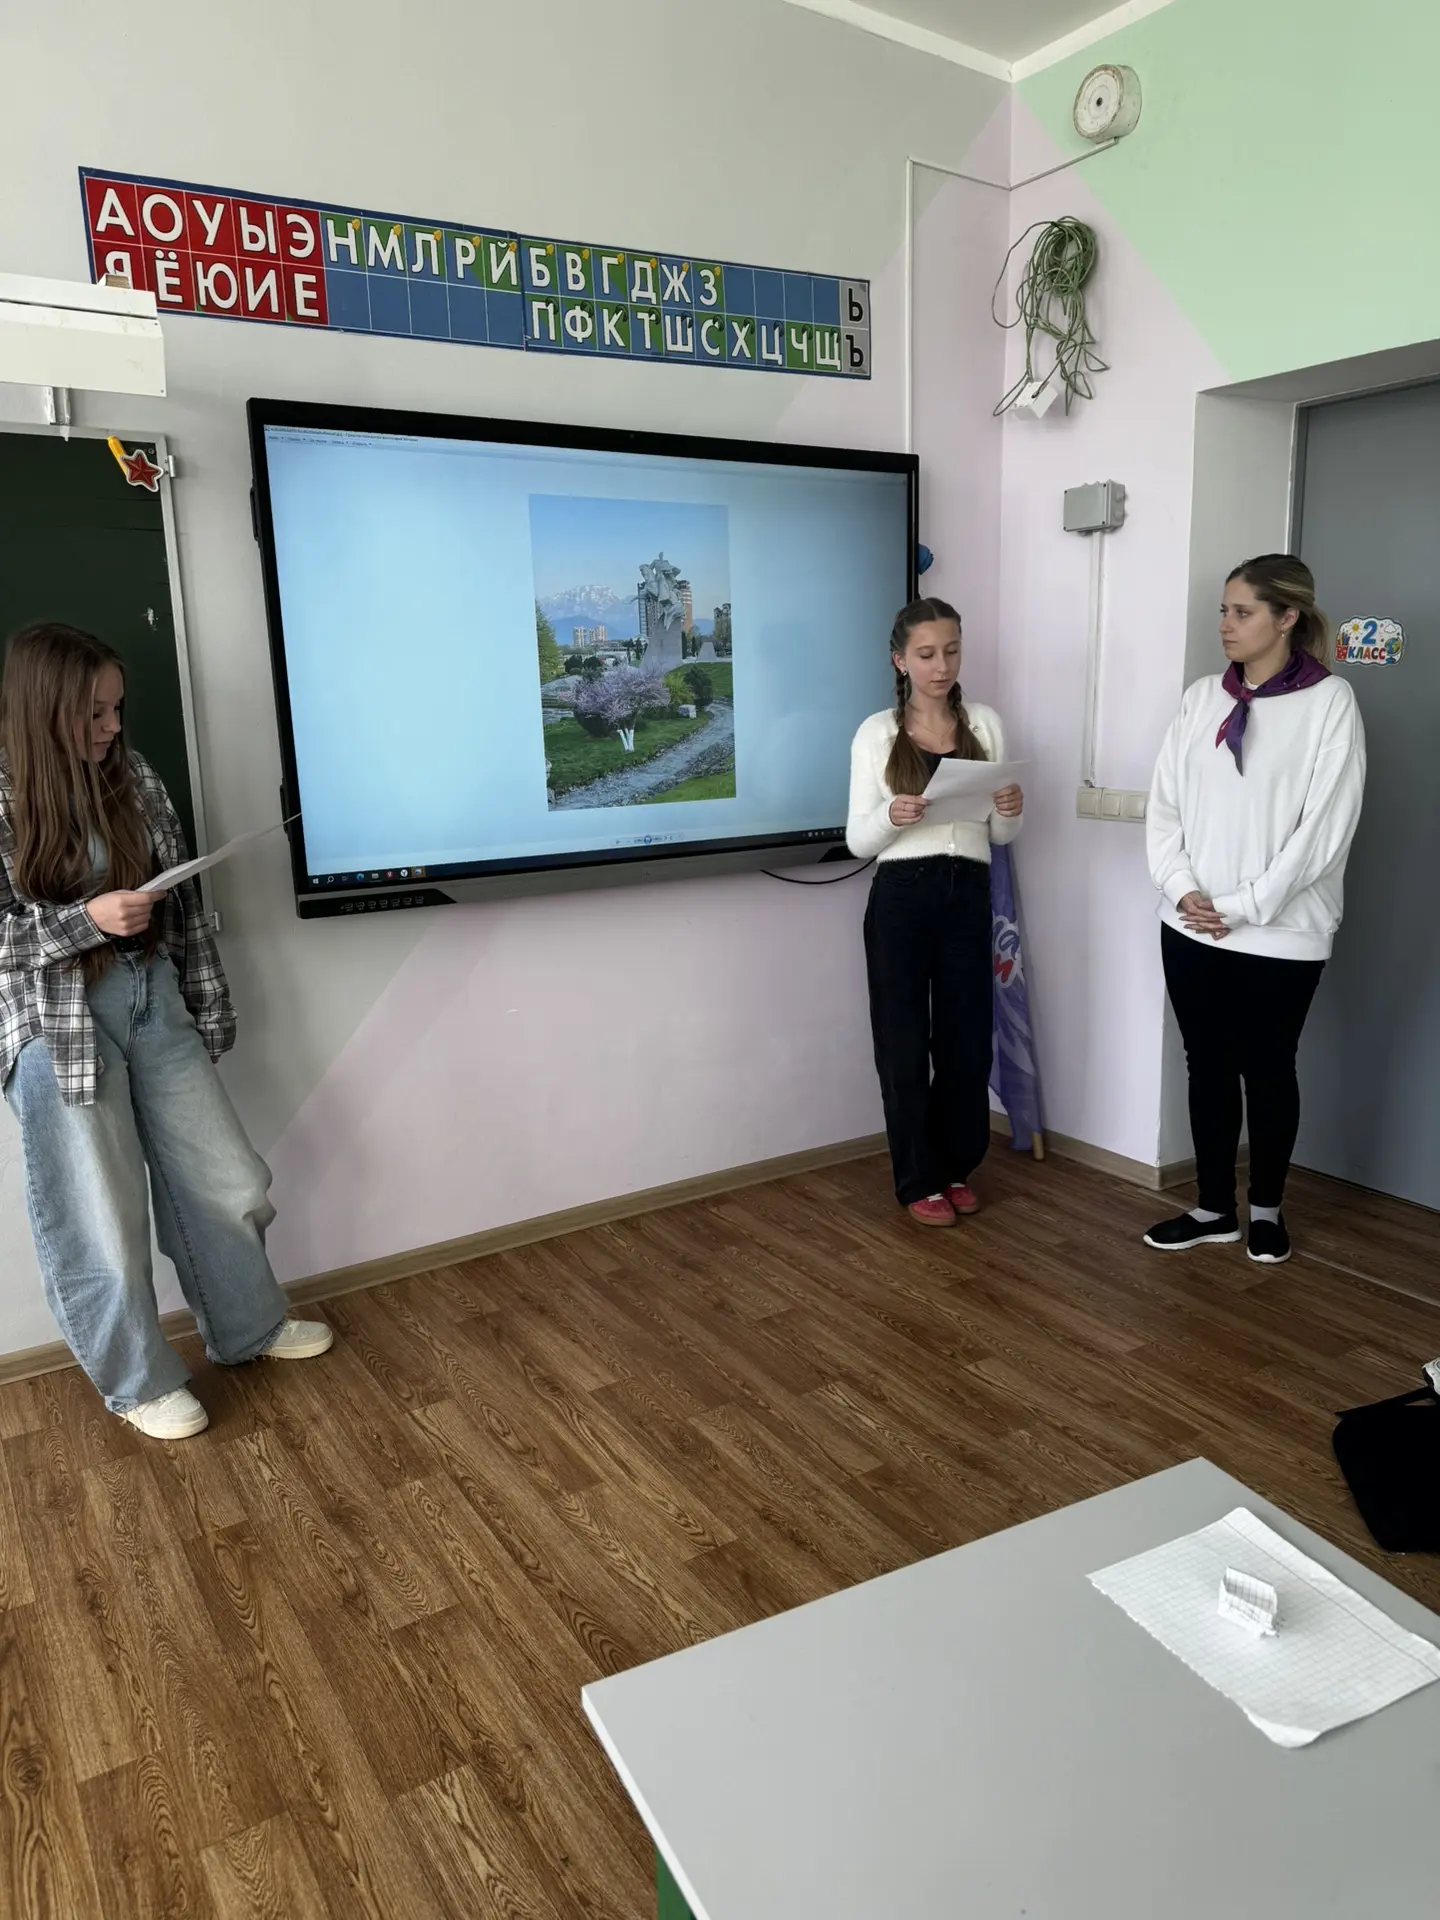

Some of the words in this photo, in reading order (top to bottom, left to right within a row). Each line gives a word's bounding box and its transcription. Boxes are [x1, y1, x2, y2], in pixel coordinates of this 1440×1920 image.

[96, 188, 135, 236] А
[142, 193, 183, 242] О
[192, 199, 225, 246] У
[239, 206, 277, 254] Ы
[286, 213, 315, 258] Э
[326, 219, 358, 265] Н
[367, 225, 405, 271] М
[411, 231, 440, 275] Л
[455, 236, 480, 280] Р
[489, 241, 518, 286] Й
[529, 247, 552, 288] Б
[565, 251, 586, 291] В
[601, 256, 620, 295] Г
[630, 260, 657, 305] Д
[660, 264, 692, 304] Ж
[699, 269, 718, 306] З
[848, 287, 864, 322] Ь
[155, 249, 183, 303] Ё
[195, 261, 238, 309] Ю
[245, 267, 279, 313] И
[294, 273, 319, 318] Е
[531, 300, 556, 341] П
[564, 305, 593, 343] Ф
[602, 308, 627, 347] К
[636, 311, 657, 350] Т
[664, 314, 694, 353] Ш
[700, 319, 720, 356] С
[731, 321, 752, 358] Х
[761, 325, 783, 365] Ц
[790, 328, 808, 363] Ч
[815, 330, 841, 371] Щ
[845, 334, 864, 368] Ъ
[1348, 646, 1386, 659] КЛАСС
[1361, 620, 1377, 644] 2
